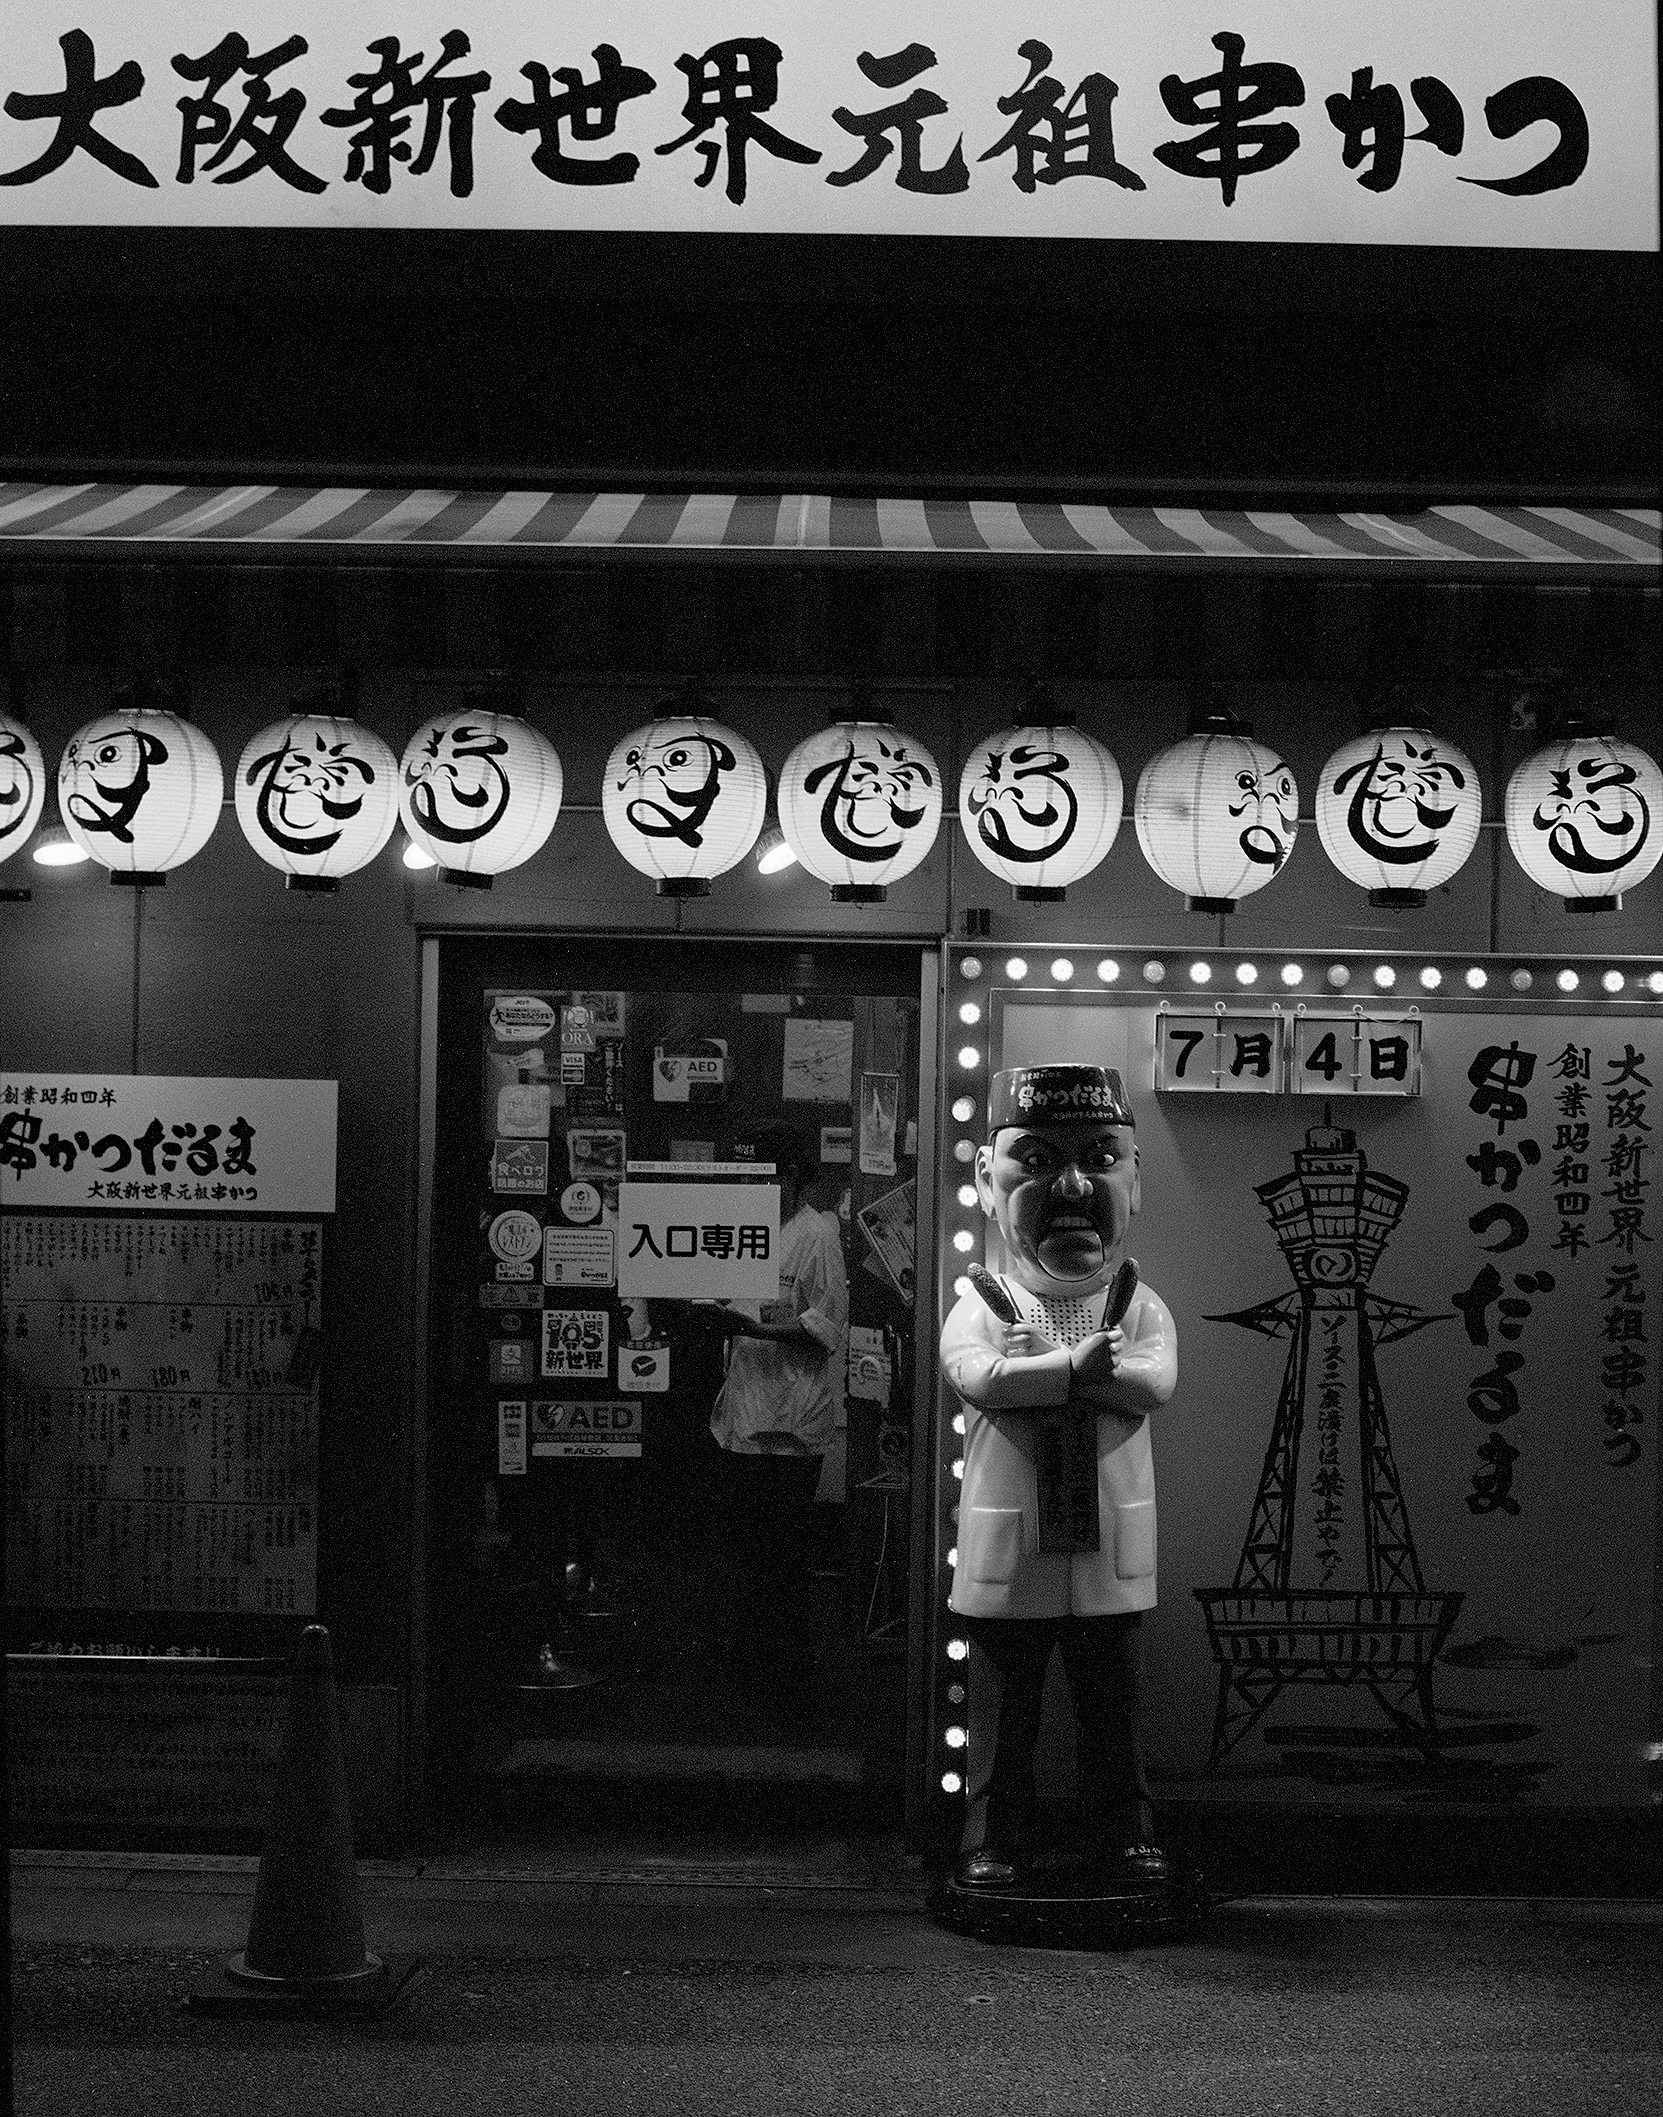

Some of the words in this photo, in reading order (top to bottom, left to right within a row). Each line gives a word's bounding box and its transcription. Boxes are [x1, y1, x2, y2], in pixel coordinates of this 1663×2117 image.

[0, 28, 1590, 208] 大阪新世界元祖串かつ
[688, 1061, 718, 1073] AED
[0, 1084, 117, 1108] 創業昭和四年
[0, 1107, 257, 1181] 串かつだるま
[1547, 1043, 1592, 1258] 創業昭和四年
[87, 1180, 258, 1201] 大阪新世界元祖串かつ
[629, 1223, 770, 1260] 入口専用
[1596, 1044, 1654, 1467] 大阪新世界元祖串かつ
[1452, 1040, 1556, 1516] 串かつだるま
[546, 1350, 604, 1370] 新世界
[568, 1406, 634, 1430] AED
